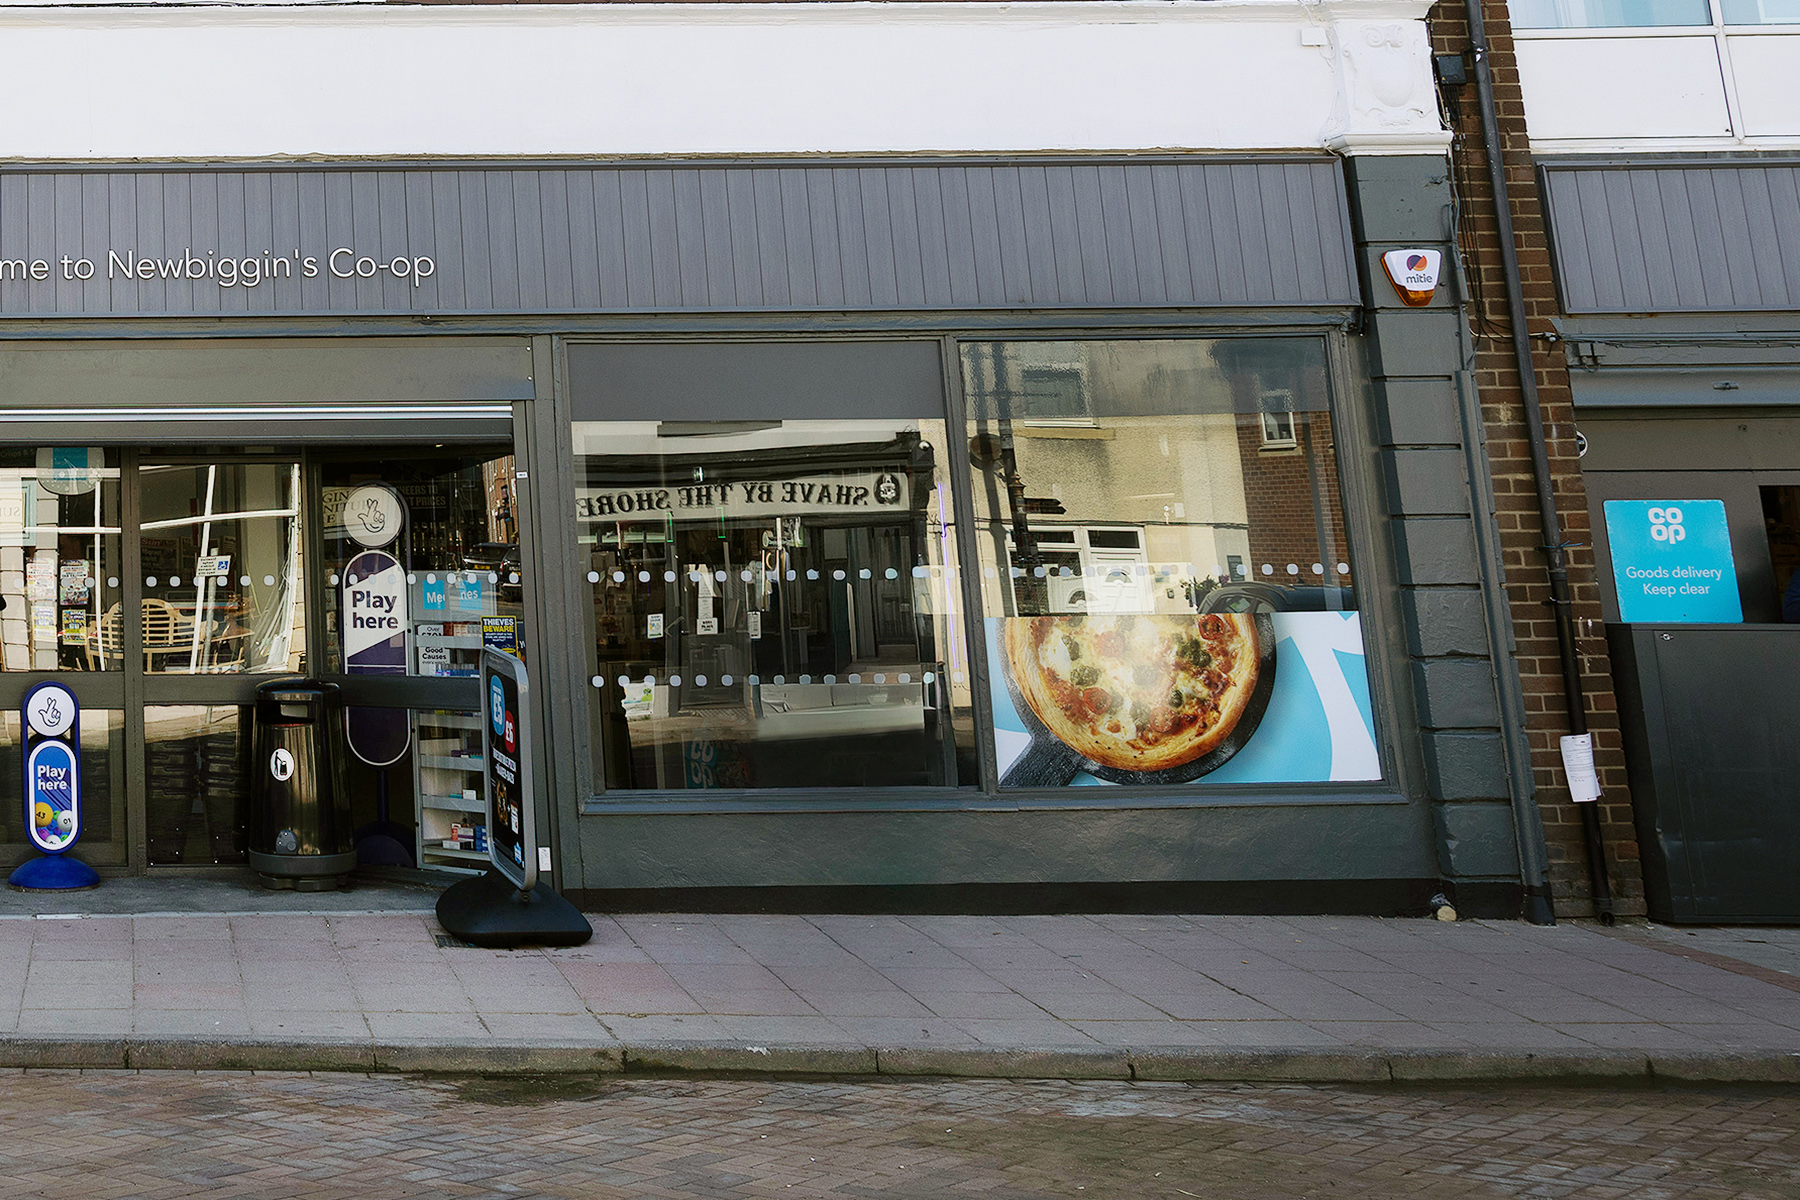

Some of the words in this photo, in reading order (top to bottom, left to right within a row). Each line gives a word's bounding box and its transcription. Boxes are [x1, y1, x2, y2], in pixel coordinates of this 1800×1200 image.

[59, 254, 95, 281] to
[108, 249, 319, 288] Newbiggin's
[328, 250, 435, 288] Co-op
[1406, 273, 1433, 284] mitie
[400, 484, 426, 496] NEERS
[1625, 566, 1670, 579] Goods
[1671, 566, 1722, 581] delivery
[1642, 583, 1677, 598] Keep
[1679, 582, 1710, 595] clear
[351, 590, 398, 613] Play
[352, 612, 399, 629] here
[483, 625, 514, 633] BEWARE
[424, 646, 443, 654] Good
[37, 765, 67, 780] Play
[37, 779, 67, 790] here
[36, 811, 46, 819] 43
